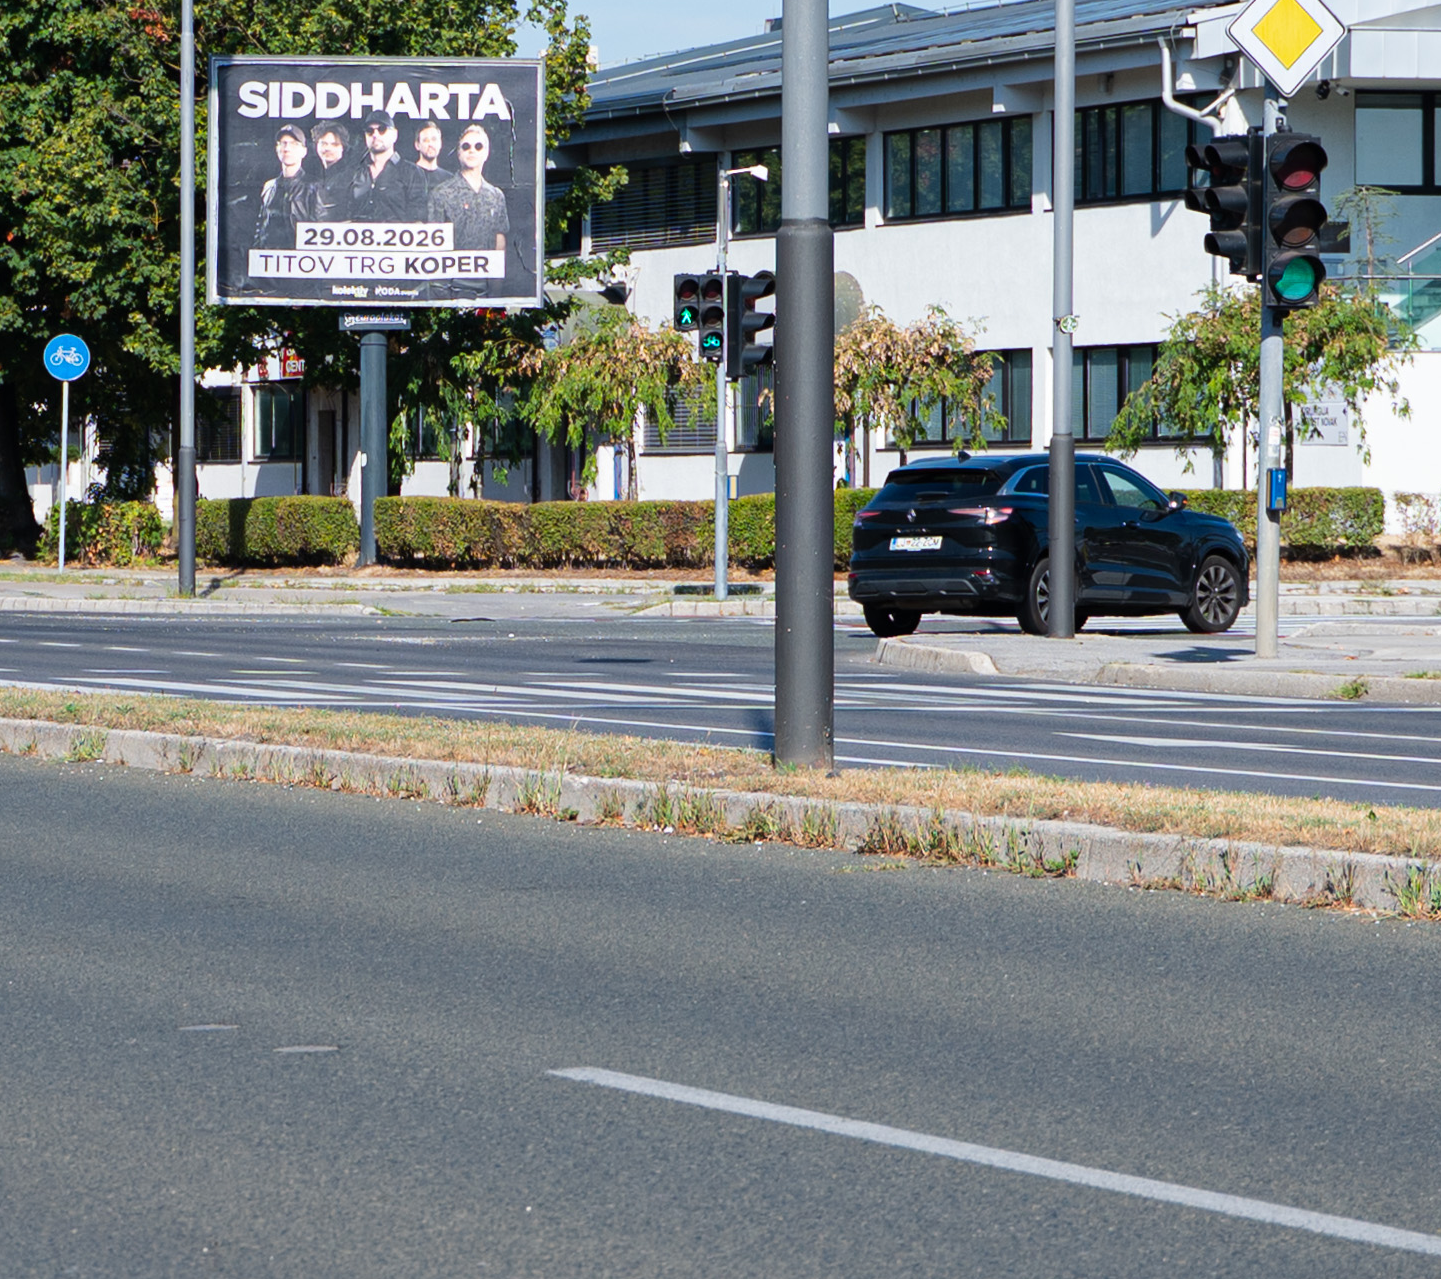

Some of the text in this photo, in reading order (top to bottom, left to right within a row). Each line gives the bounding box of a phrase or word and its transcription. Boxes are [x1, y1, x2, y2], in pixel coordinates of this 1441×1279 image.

[237, 81, 511, 121] SIDDHARTA
[303, 228, 445, 247] 29.08.2026
[259, 254, 489, 274] TITOV TRG KOPER
